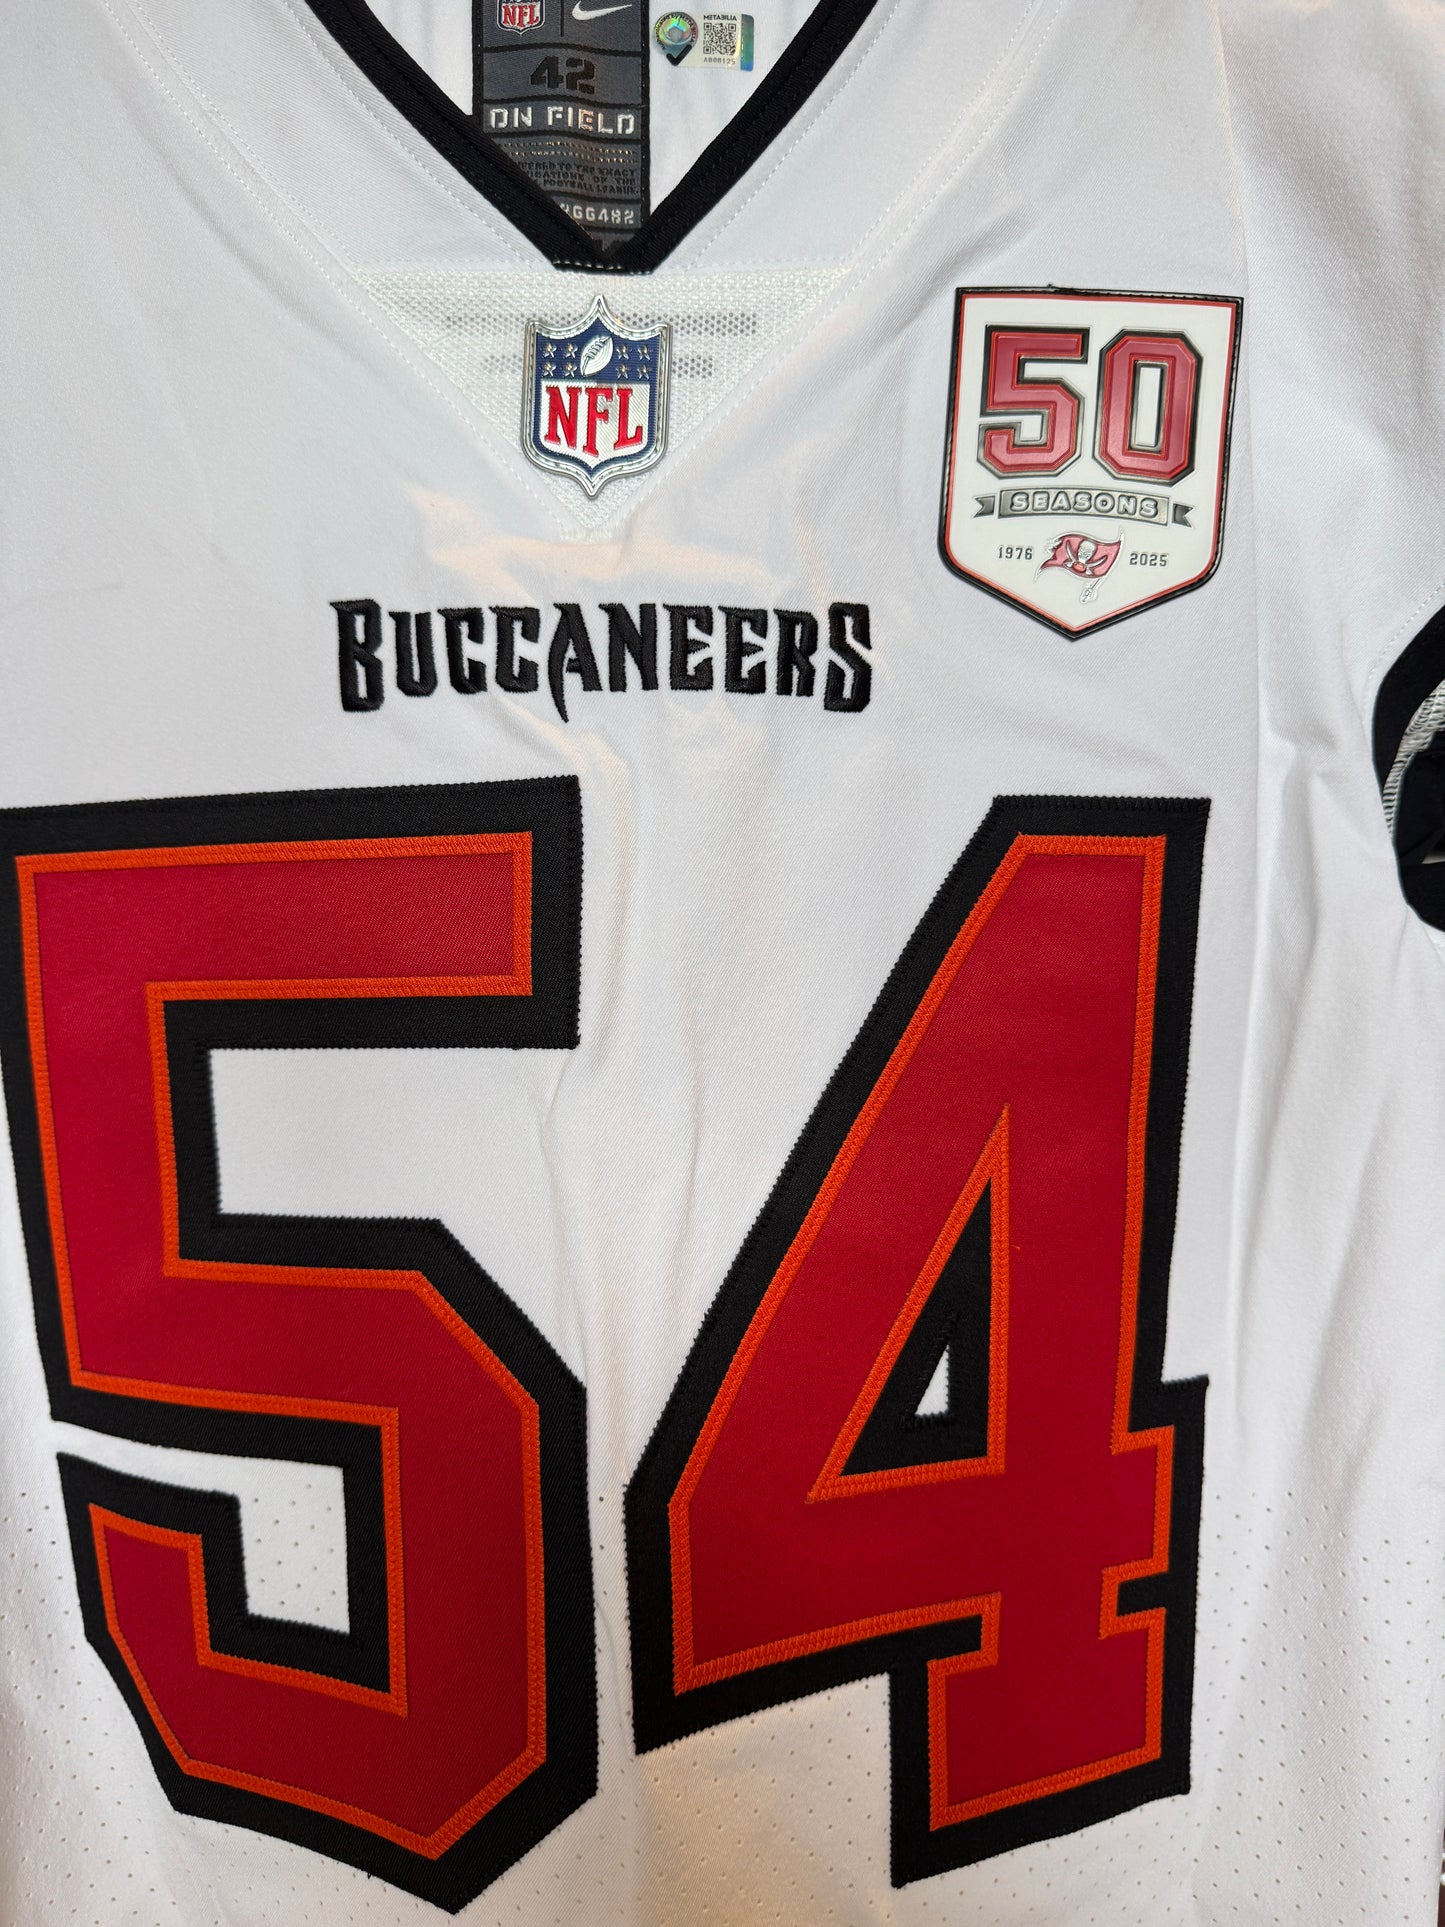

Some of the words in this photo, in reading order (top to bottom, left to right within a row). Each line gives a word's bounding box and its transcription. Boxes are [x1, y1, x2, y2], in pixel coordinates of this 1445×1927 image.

[502, 4, 539, 28] NFL
[529, 56, 595, 95] 42
[490, 108, 533, 129] ON
[547, 106, 635, 135] FIELD
[543, 385, 644, 458] NFL
[977, 324, 1203, 487] 50
[1009, 491, 1158, 519] SEASONS
[998, 547, 1033, 560] 1976
[1129, 552, 1168, 567] 2025
[329, 598, 873, 722] BUCCANEERS
[0, 775, 1211, 1914] 54
